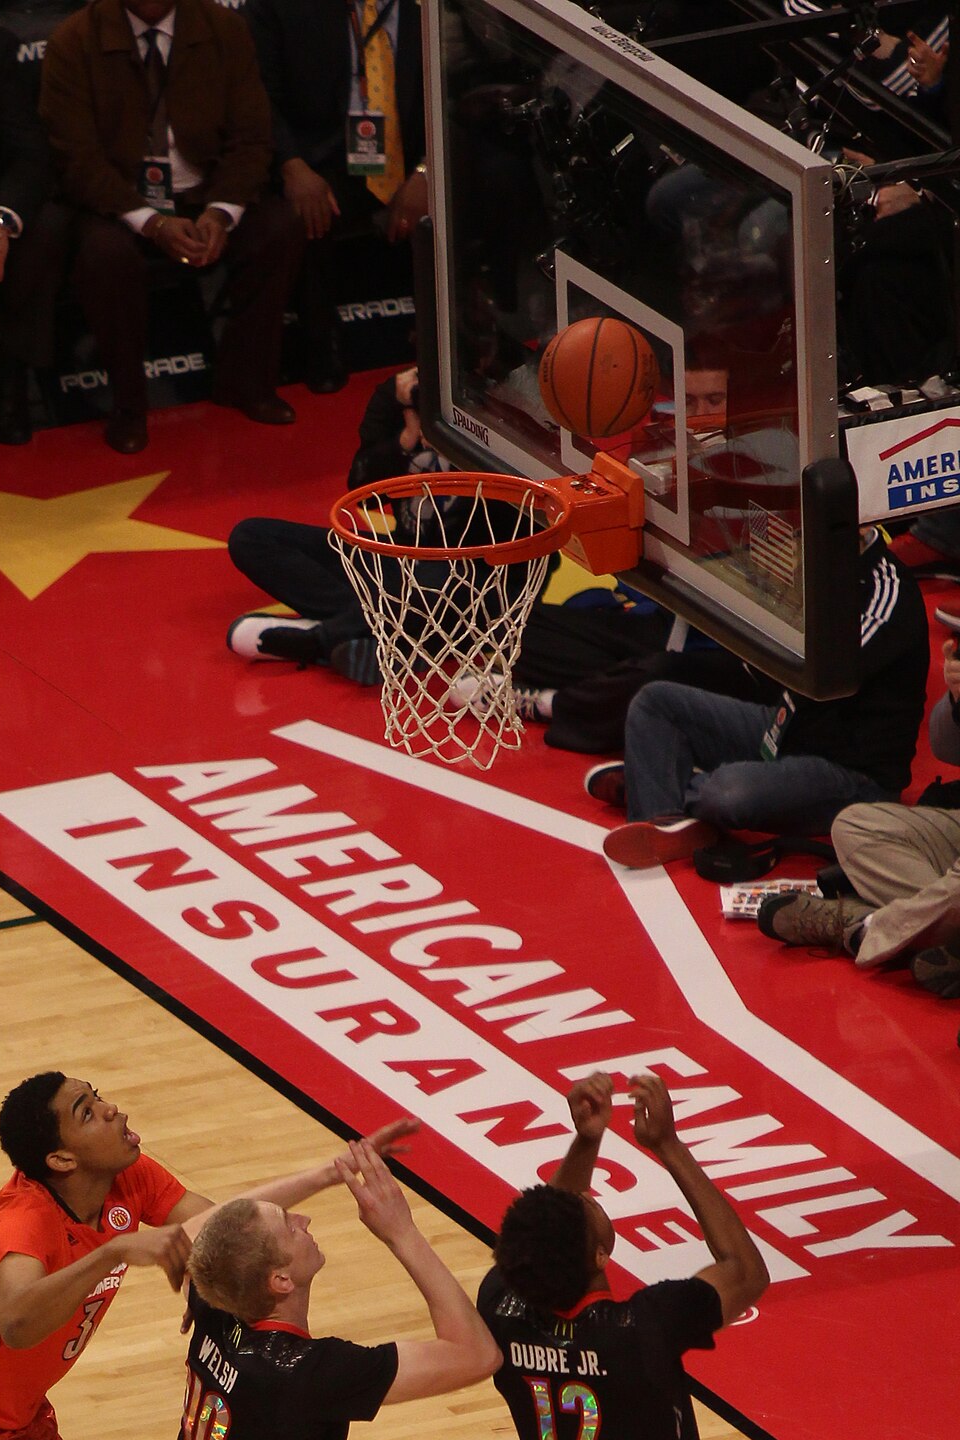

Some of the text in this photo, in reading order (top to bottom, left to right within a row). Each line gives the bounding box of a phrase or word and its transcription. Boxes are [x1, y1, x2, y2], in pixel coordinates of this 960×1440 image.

[452, 406, 490, 448] SPALDING
[65, 816, 706, 1253] INSURANCE
[135, 757, 957, 1258] AMERICAN FAMILY
[197, 1334, 240, 1395] WELSH
[510, 1340, 608, 1377] OUBRE JR.
